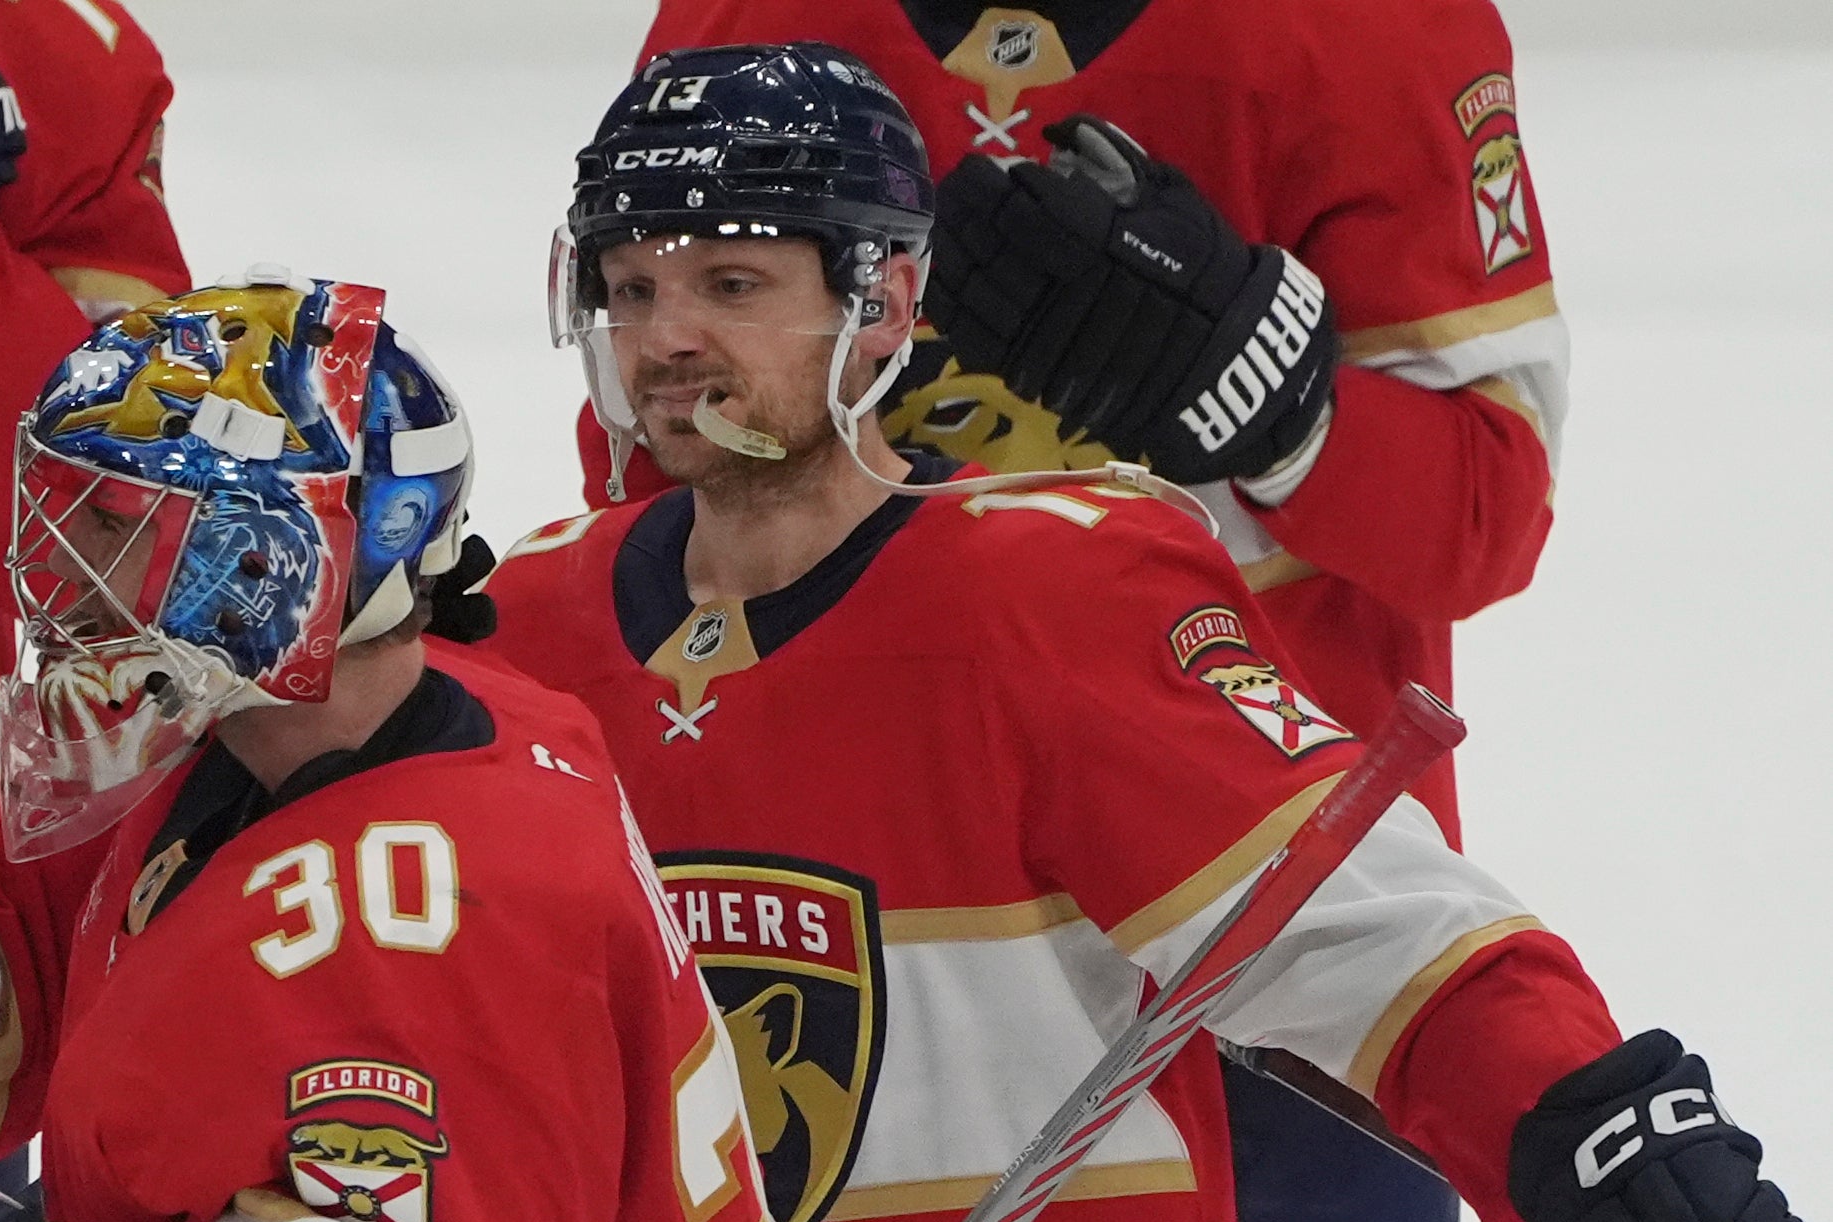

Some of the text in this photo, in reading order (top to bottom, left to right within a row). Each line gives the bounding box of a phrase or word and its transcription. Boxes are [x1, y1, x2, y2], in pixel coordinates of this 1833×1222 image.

[646, 76, 712, 113] 13
[614, 146, 718, 171] CCM
[1180, 616, 1238, 654] FLORIDA
[242, 820, 460, 981] 30
[666, 891, 829, 955] HERS
[307, 1069, 419, 1100] FLORIDA
[1574, 1087, 1737, 1189] CC
